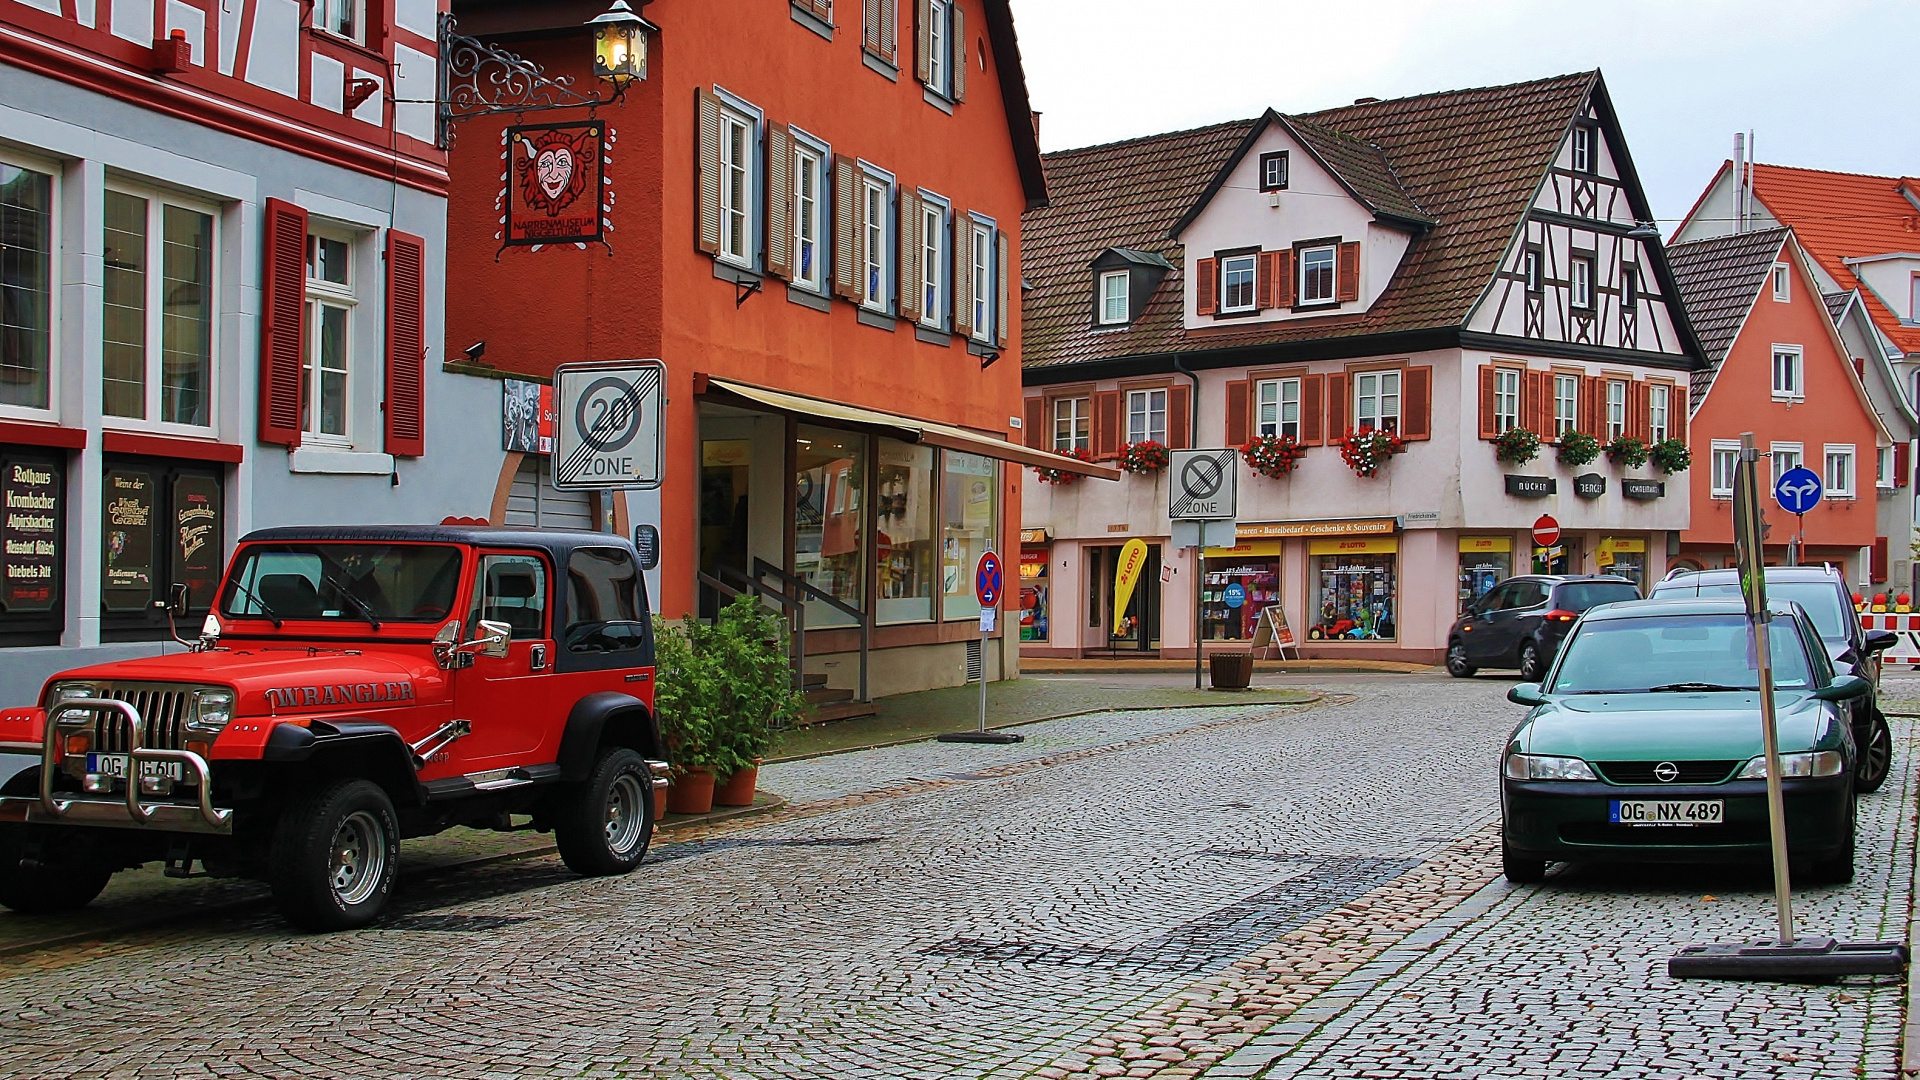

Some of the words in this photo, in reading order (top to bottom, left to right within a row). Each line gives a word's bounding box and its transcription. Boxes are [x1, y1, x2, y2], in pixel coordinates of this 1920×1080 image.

[513, 217, 595, 231] NARRENMUSEUM
[524, 227, 582, 239] NIGGELTURM
[582, 457, 633, 476] ZONE
[13, 465, 51, 486] Rothaus
[114, 477, 132, 488] Weine
[132, 478, 145, 489] der
[1518, 480, 1547, 491] BÜCHER
[6, 489, 56, 509] Krombacher
[1185, 502, 1218, 514] ZONE
[6, 513, 55, 531] Alpirsbacher
[1264, 525, 1304, 534] Bastelbedarf
[1310, 523, 1344, 533] Geschenke
[1353, 522, 1387, 531] Souvenirs
[1125, 547, 1140, 574] LOTTO
[7, 564, 38, 578] Diebels
[38, 564, 52, 578] Alt
[108, 569, 138, 579] Bedienung
[1228, 589, 1242, 597] 15%
[275, 681, 415, 708] WRANGLER
[102, 756, 122, 775] OG
[1621, 802, 1645, 820] OG
[1657, 802, 1682, 820] NX
[1685, 802, 1721, 820] 489
